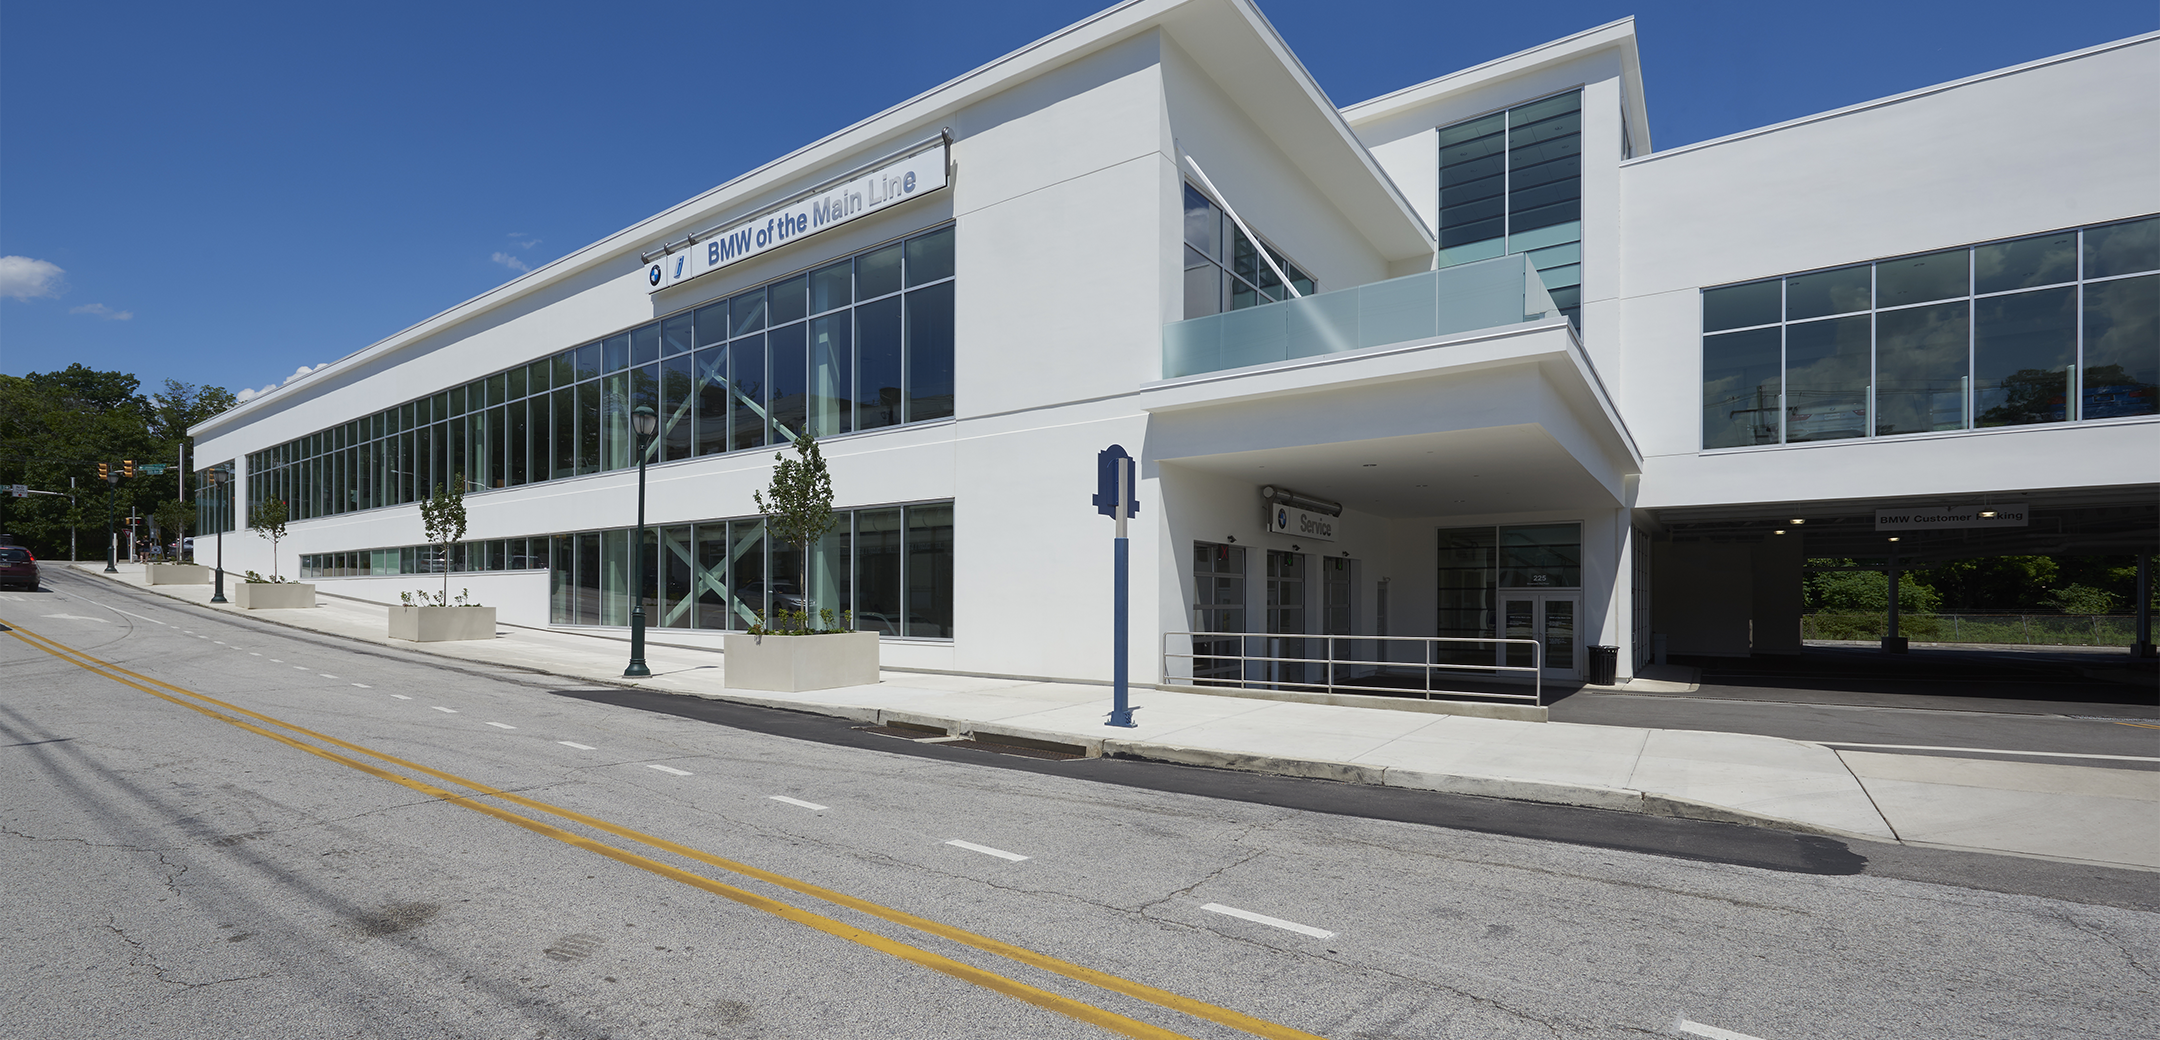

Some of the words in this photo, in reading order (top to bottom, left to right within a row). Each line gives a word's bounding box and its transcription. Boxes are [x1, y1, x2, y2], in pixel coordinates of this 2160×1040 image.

[708, 227, 752, 266] BMW
[756, 218, 775, 248] of
[777, 213, 808, 240] the
[813, 189, 862, 228] Main
[868, 169, 917, 207] Line
[1300, 513, 1331, 536] Service
[1880, 515, 1910, 524] BMW
[1914, 514, 1972, 523] Customer
[1976, 511, 2023, 521] Pking
[1533, 574, 1547, 582] 225
